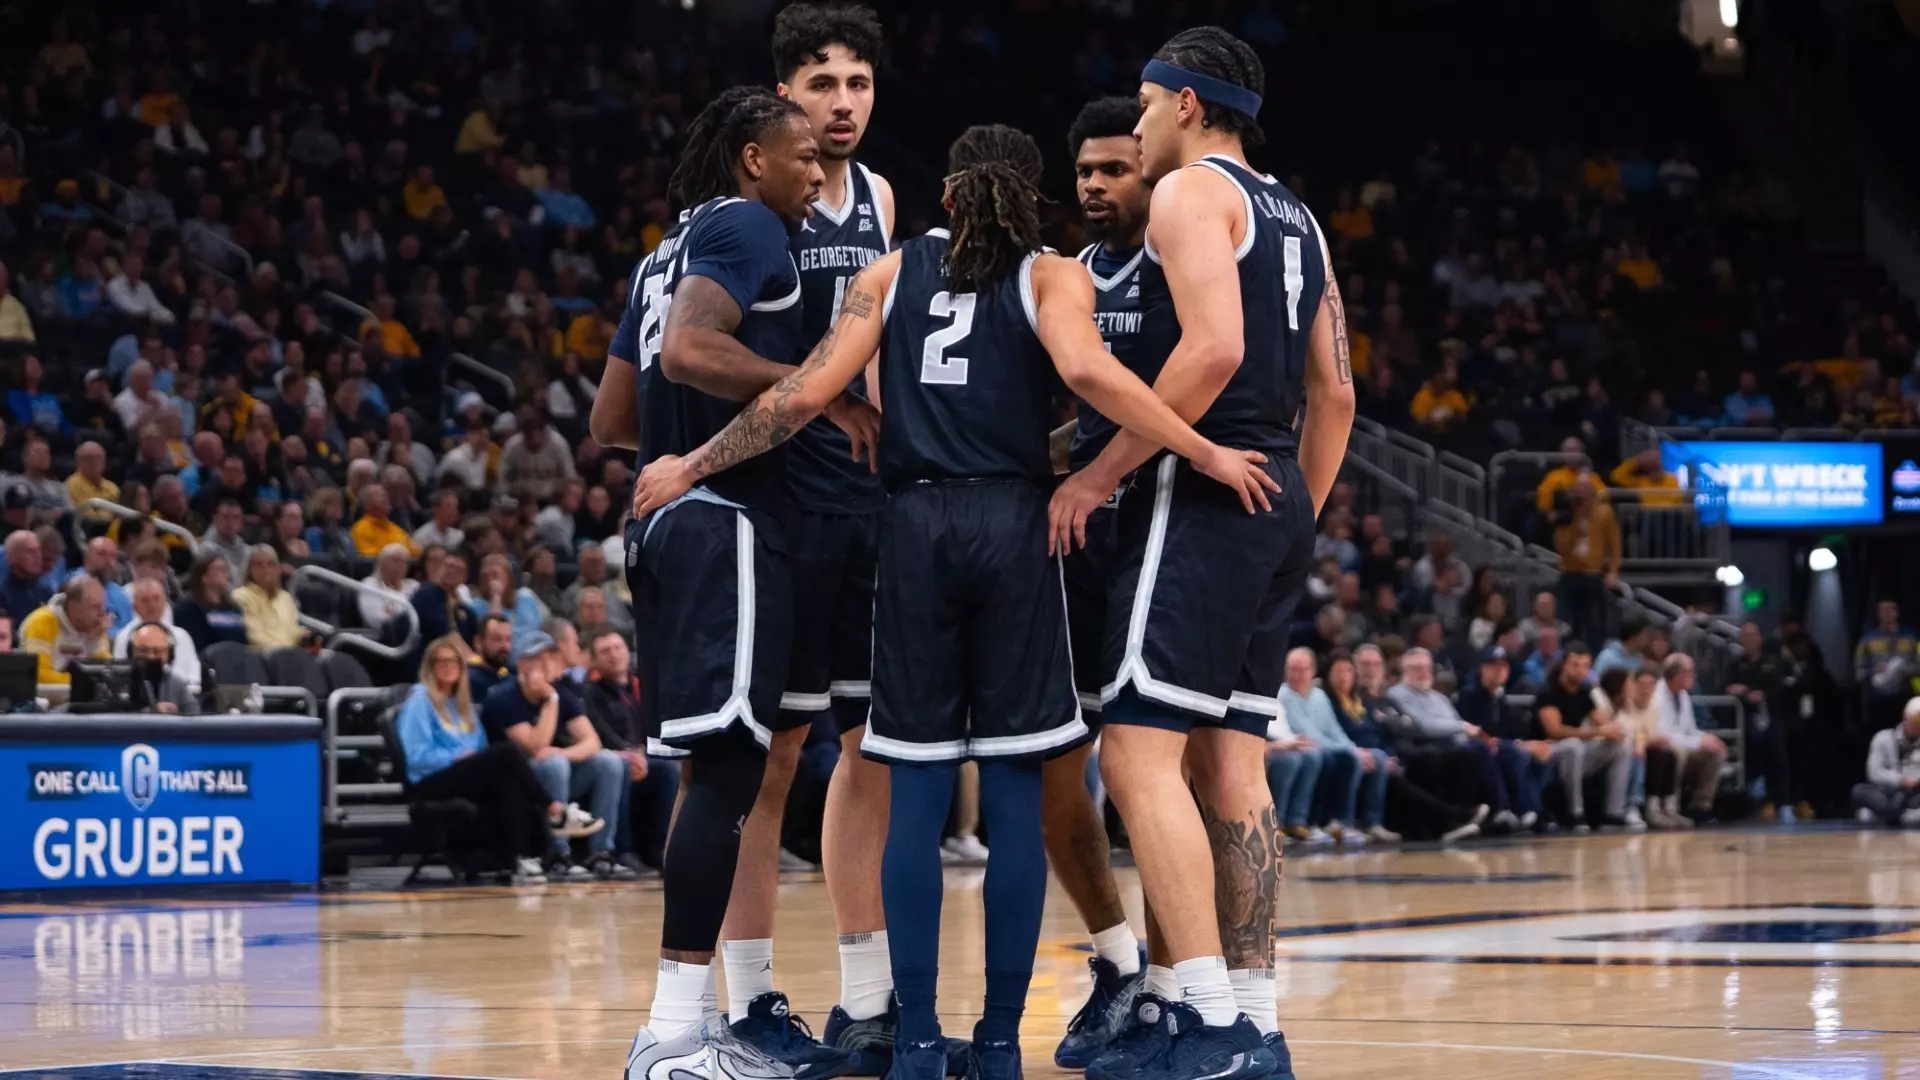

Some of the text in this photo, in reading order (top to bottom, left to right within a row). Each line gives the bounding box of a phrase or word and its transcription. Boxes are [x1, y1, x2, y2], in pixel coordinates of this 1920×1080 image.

[920, 290, 977, 385] 2
[34, 770, 74, 794] ONE
[76, 770, 120, 793] CALL
[160, 769, 215, 792] THAT'S
[217, 769, 249, 792] ALL
[33, 815, 245, 880] GRUBER
